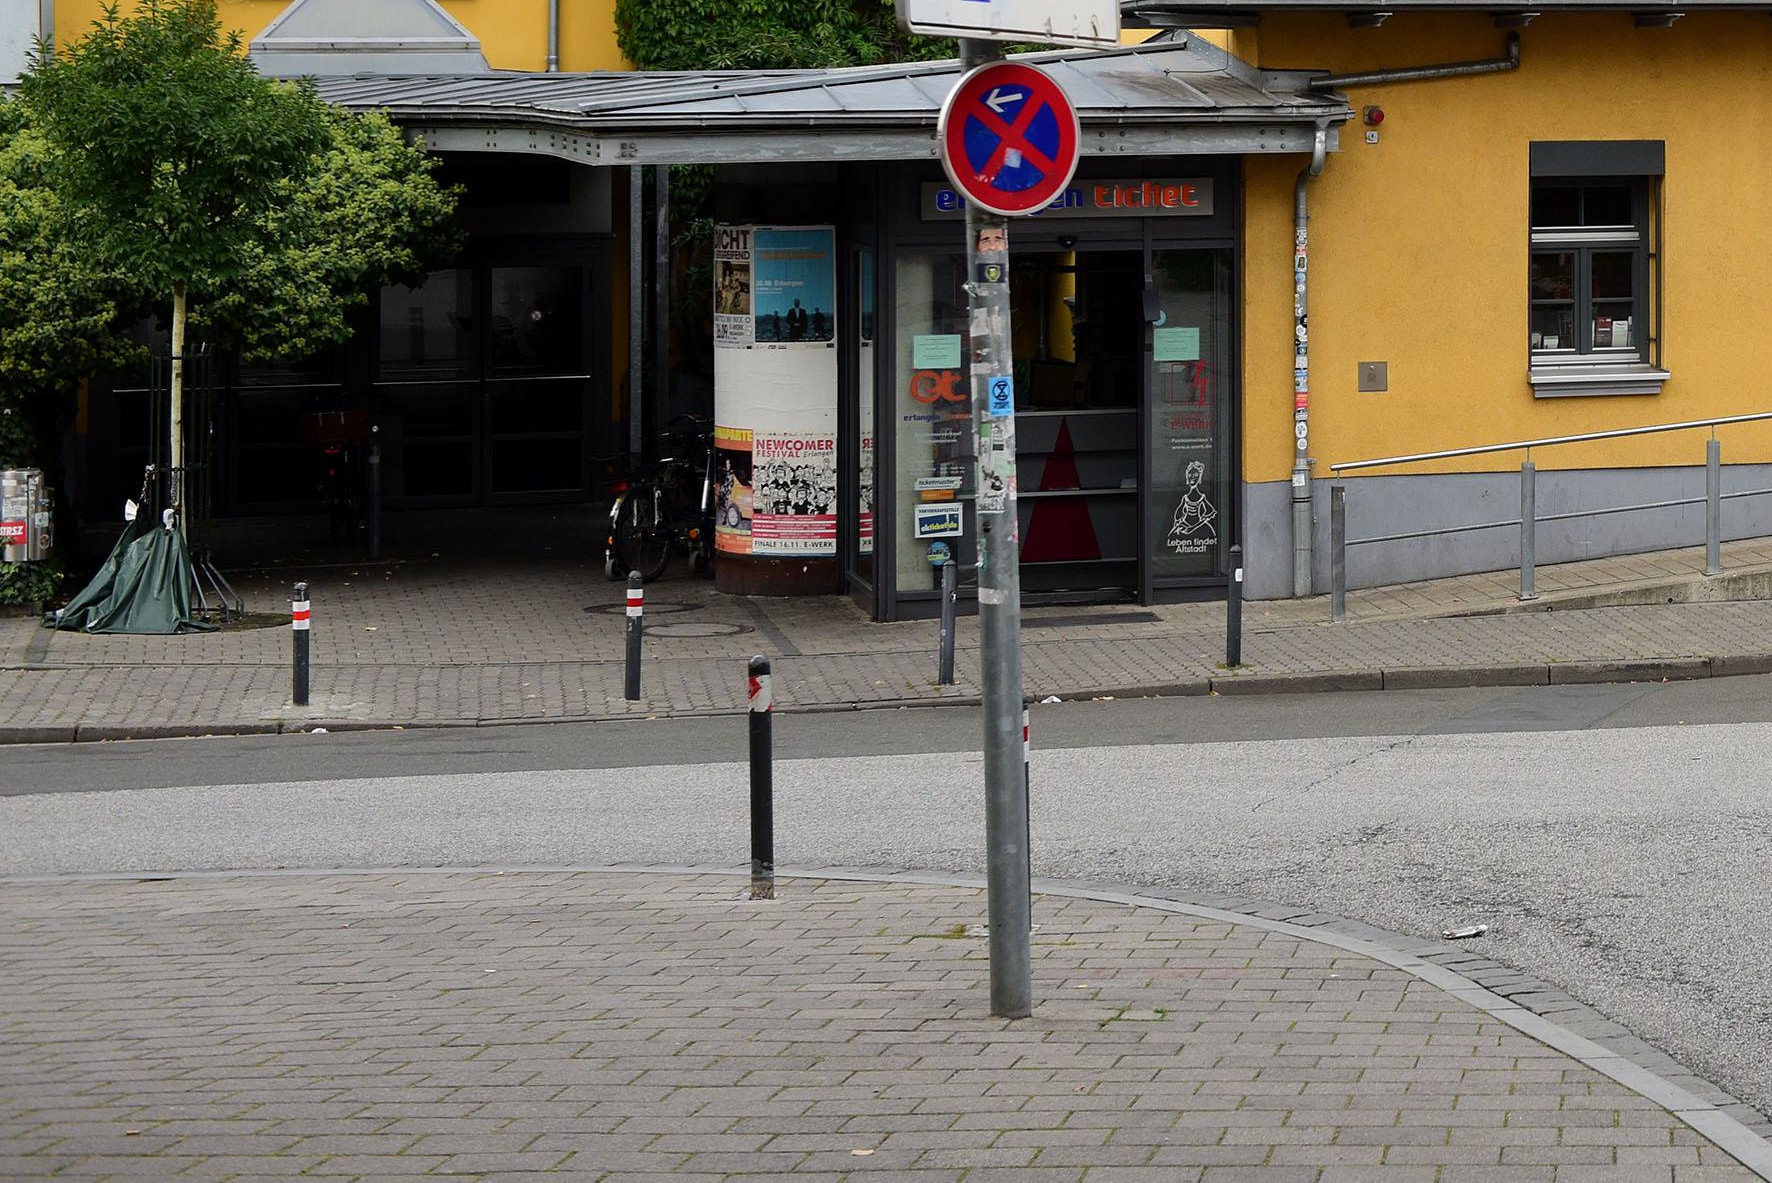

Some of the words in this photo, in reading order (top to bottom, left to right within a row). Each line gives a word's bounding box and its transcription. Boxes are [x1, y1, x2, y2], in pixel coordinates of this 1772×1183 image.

[1095, 181, 1201, 209] ticket
[756, 439, 834, 451] NEWCOMER
[756, 449, 801, 458] FESTIVAL
[803, 450, 834, 458] Erlangen
[755, 540, 777, 548] FINALE
[804, 540, 834, 548] E-WERK
[1167, 538, 1193, 547] Leben
[1193, 537, 1218, 546] findet
[1175, 545, 1207, 553] Altstadt
